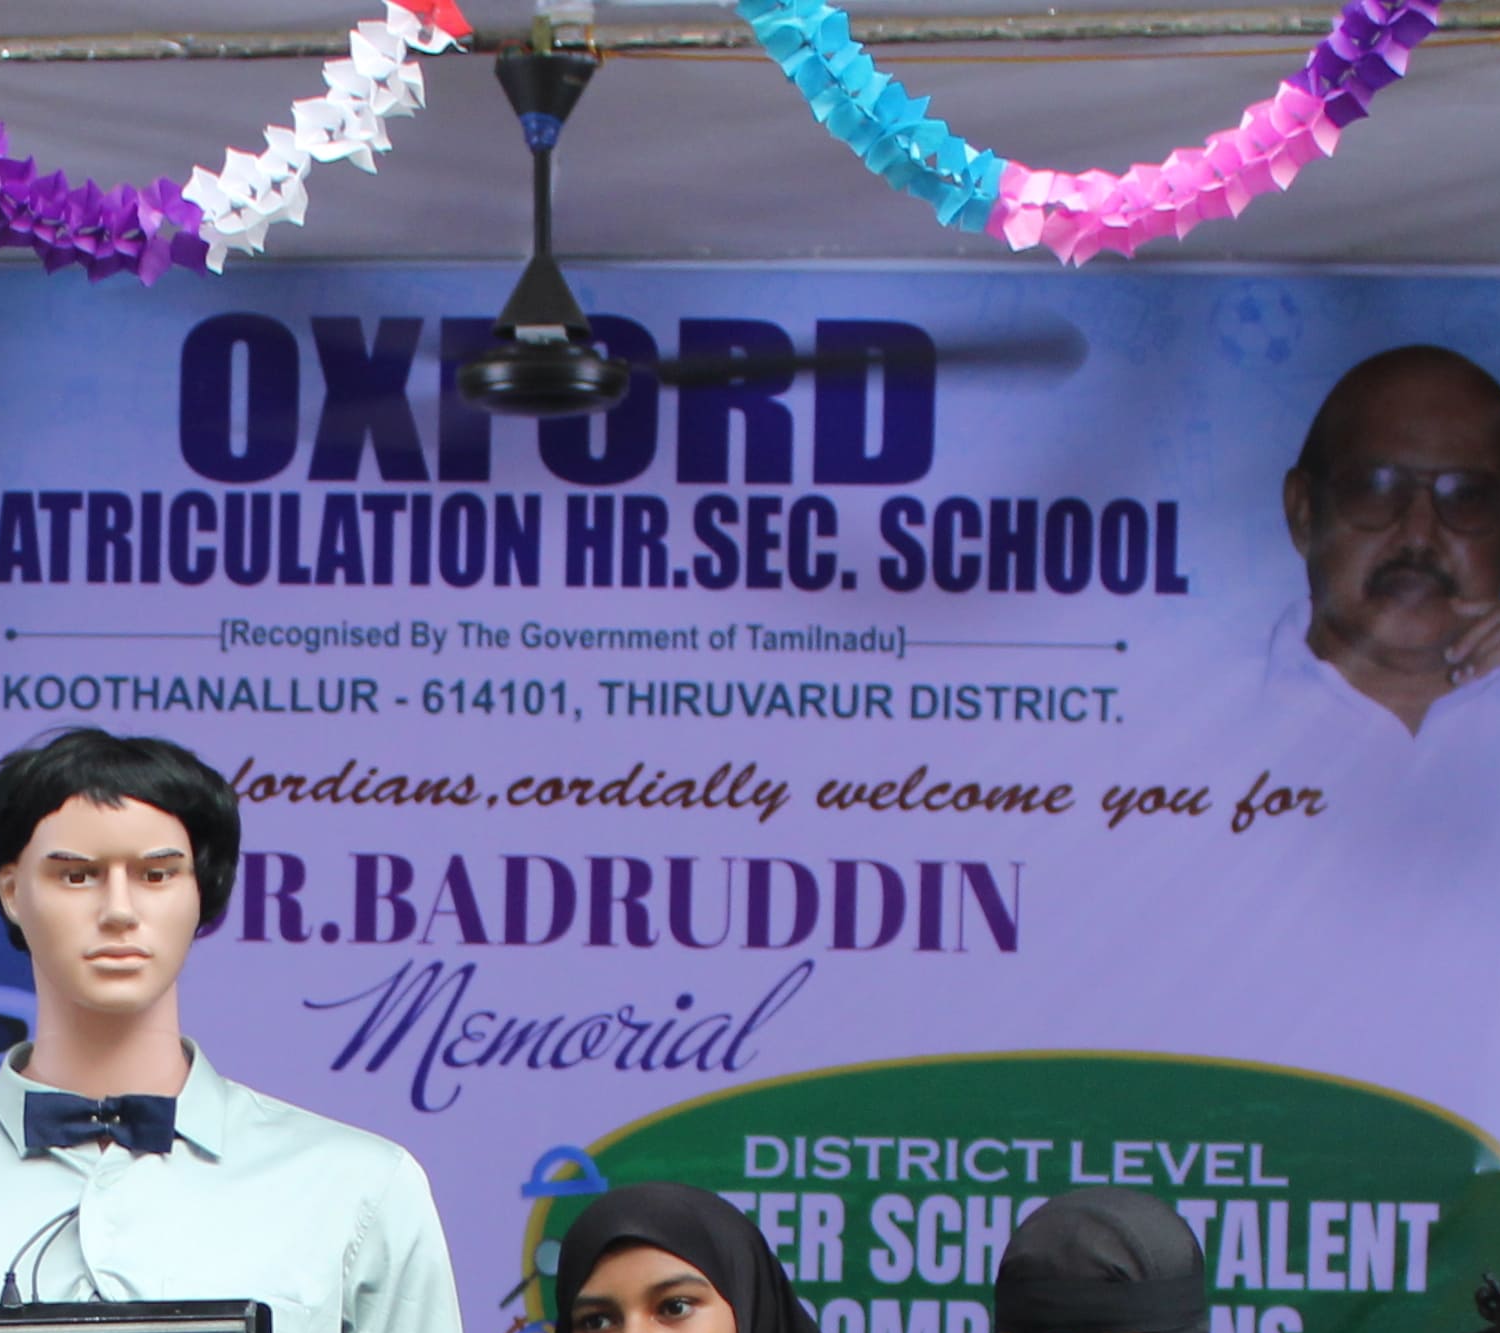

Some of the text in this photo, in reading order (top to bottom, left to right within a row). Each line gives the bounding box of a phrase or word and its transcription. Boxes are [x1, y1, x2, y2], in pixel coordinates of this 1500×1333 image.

[565, 492, 857, 594] HR.SEC.
[879, 494, 1190, 597] SCHOOL
[219, 618, 907, 660] [Recognised By The Government of Tamilnadu]
[2, 675, 379, 715] KOOTHANALLUR
[422, 678, 584, 723] 614101,
[597, 680, 894, 720] THIRUVARUR
[909, 686, 1124, 724] DISTRICT.
[815, 764, 1076, 814] welcome
[1100, 782, 1212, 829] you
[1230, 769, 1329, 834] for
[194, 850, 1027, 954] R.BADRUDDIN
[303, 958, 815, 1114] Memorial
[744, 1135, 1290, 1188] DISTRICT LEVEL
[1176, 1198, 1441, 1292] TALENT
